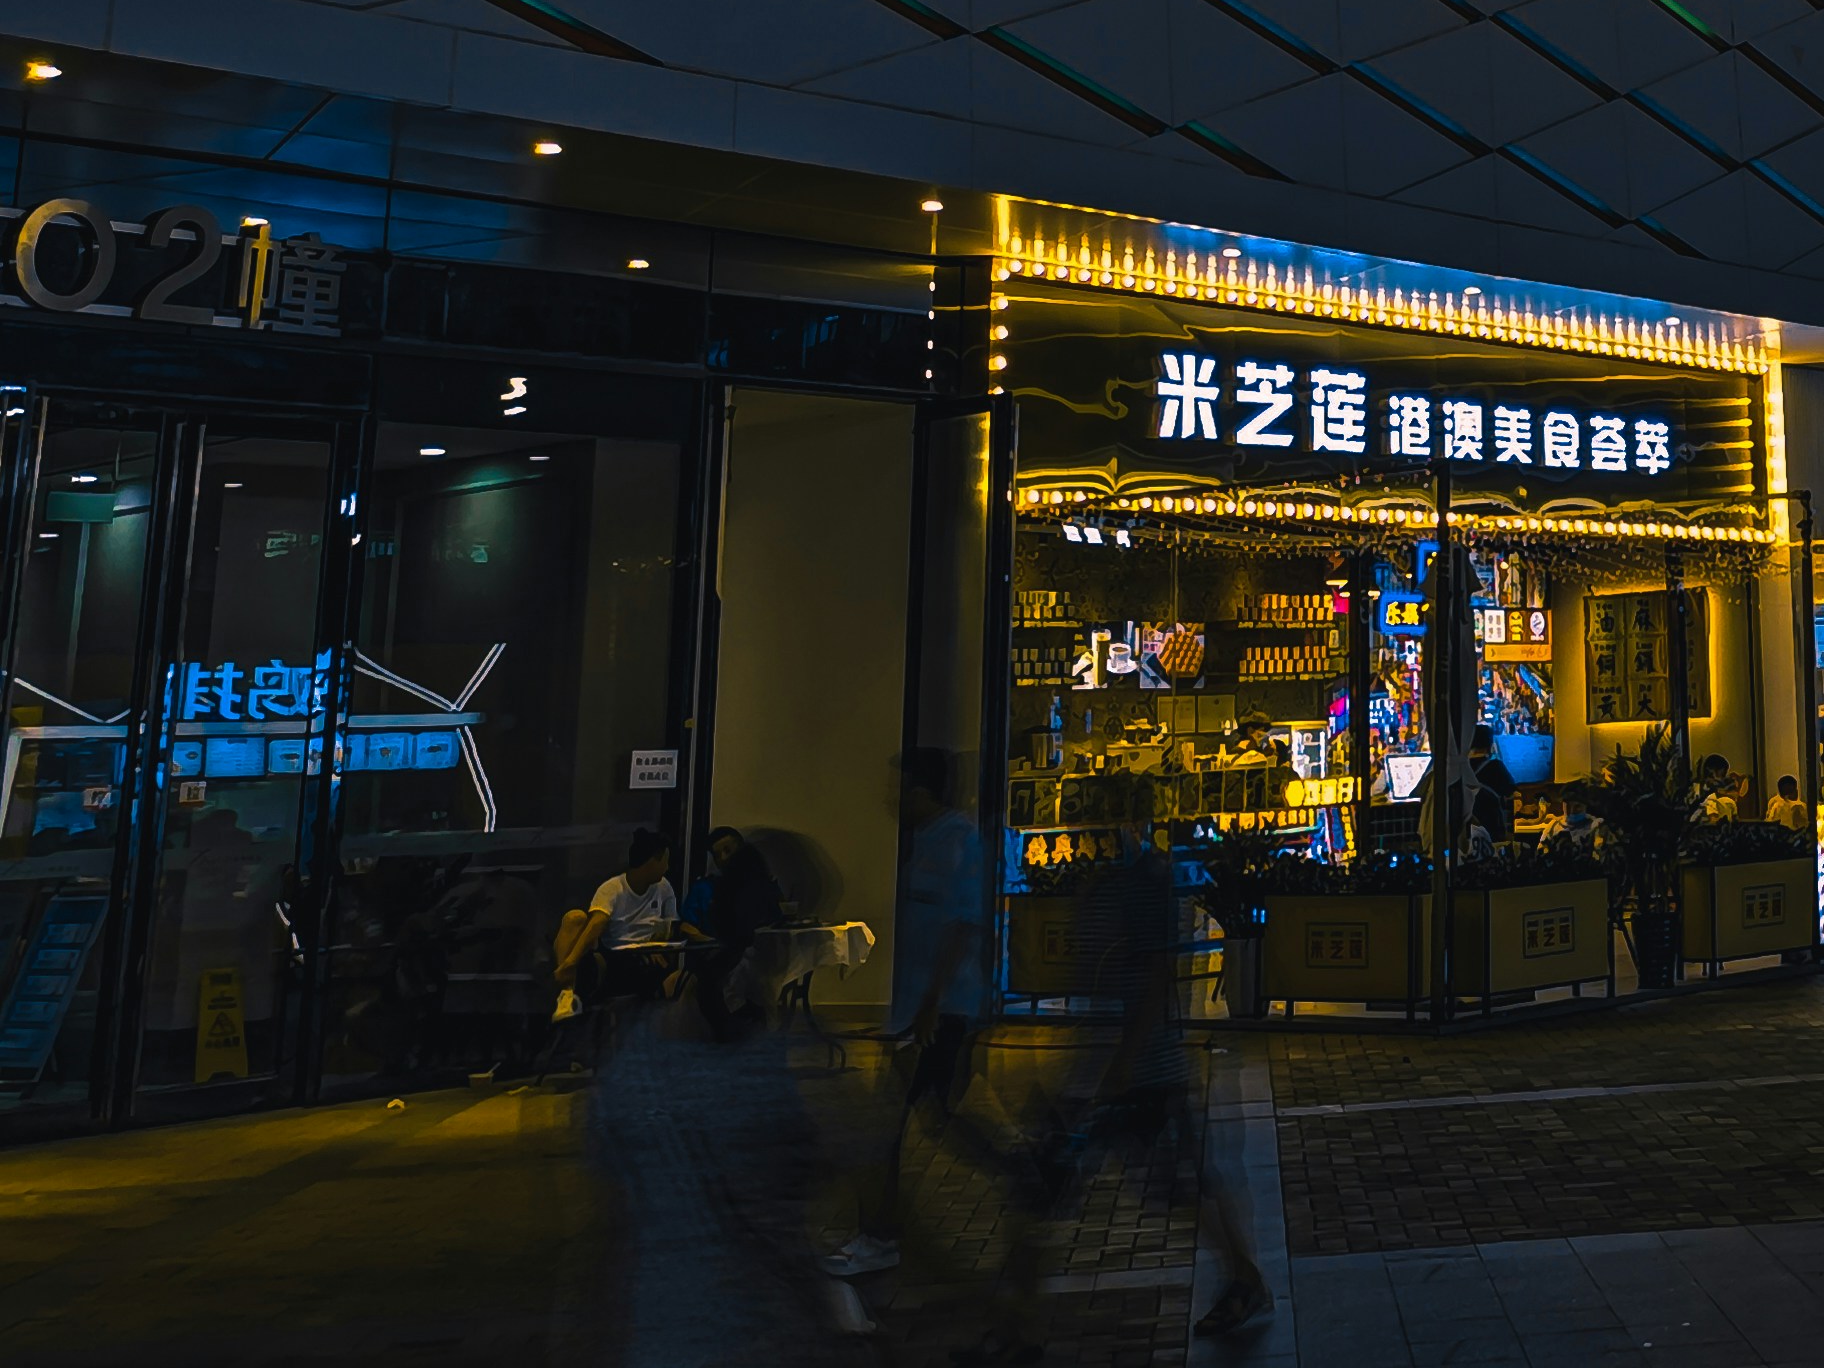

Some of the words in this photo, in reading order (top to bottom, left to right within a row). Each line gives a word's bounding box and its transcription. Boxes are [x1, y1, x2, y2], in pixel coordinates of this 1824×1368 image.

[1157, 354, 1367, 453] 米芝莲
[1389, 395, 1671, 474] 港澳美食荟萃
